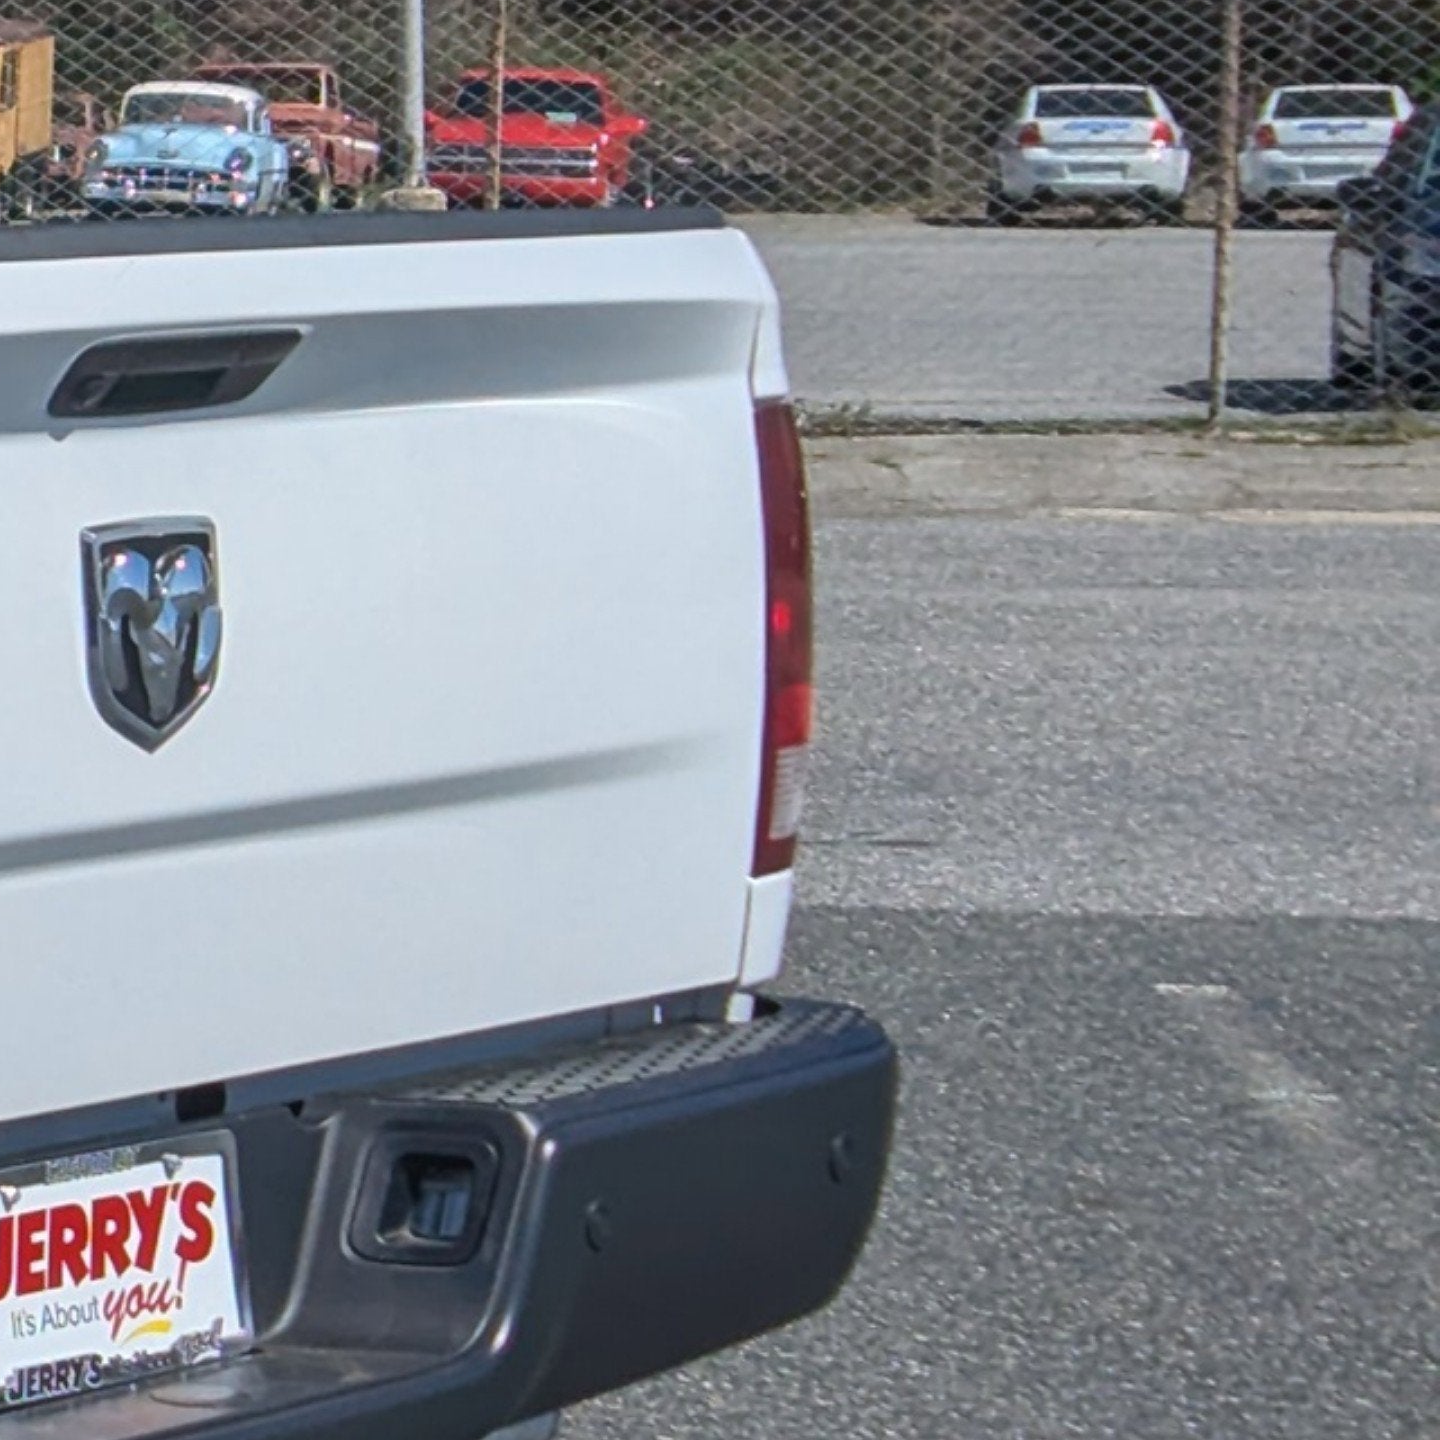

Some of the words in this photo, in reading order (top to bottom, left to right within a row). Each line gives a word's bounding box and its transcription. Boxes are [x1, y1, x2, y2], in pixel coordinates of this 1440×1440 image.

[11, 1310, 37, 1339] It's
[41, 1297, 100, 1333] About
[7, 1355, 103, 1401] JERRY'S
